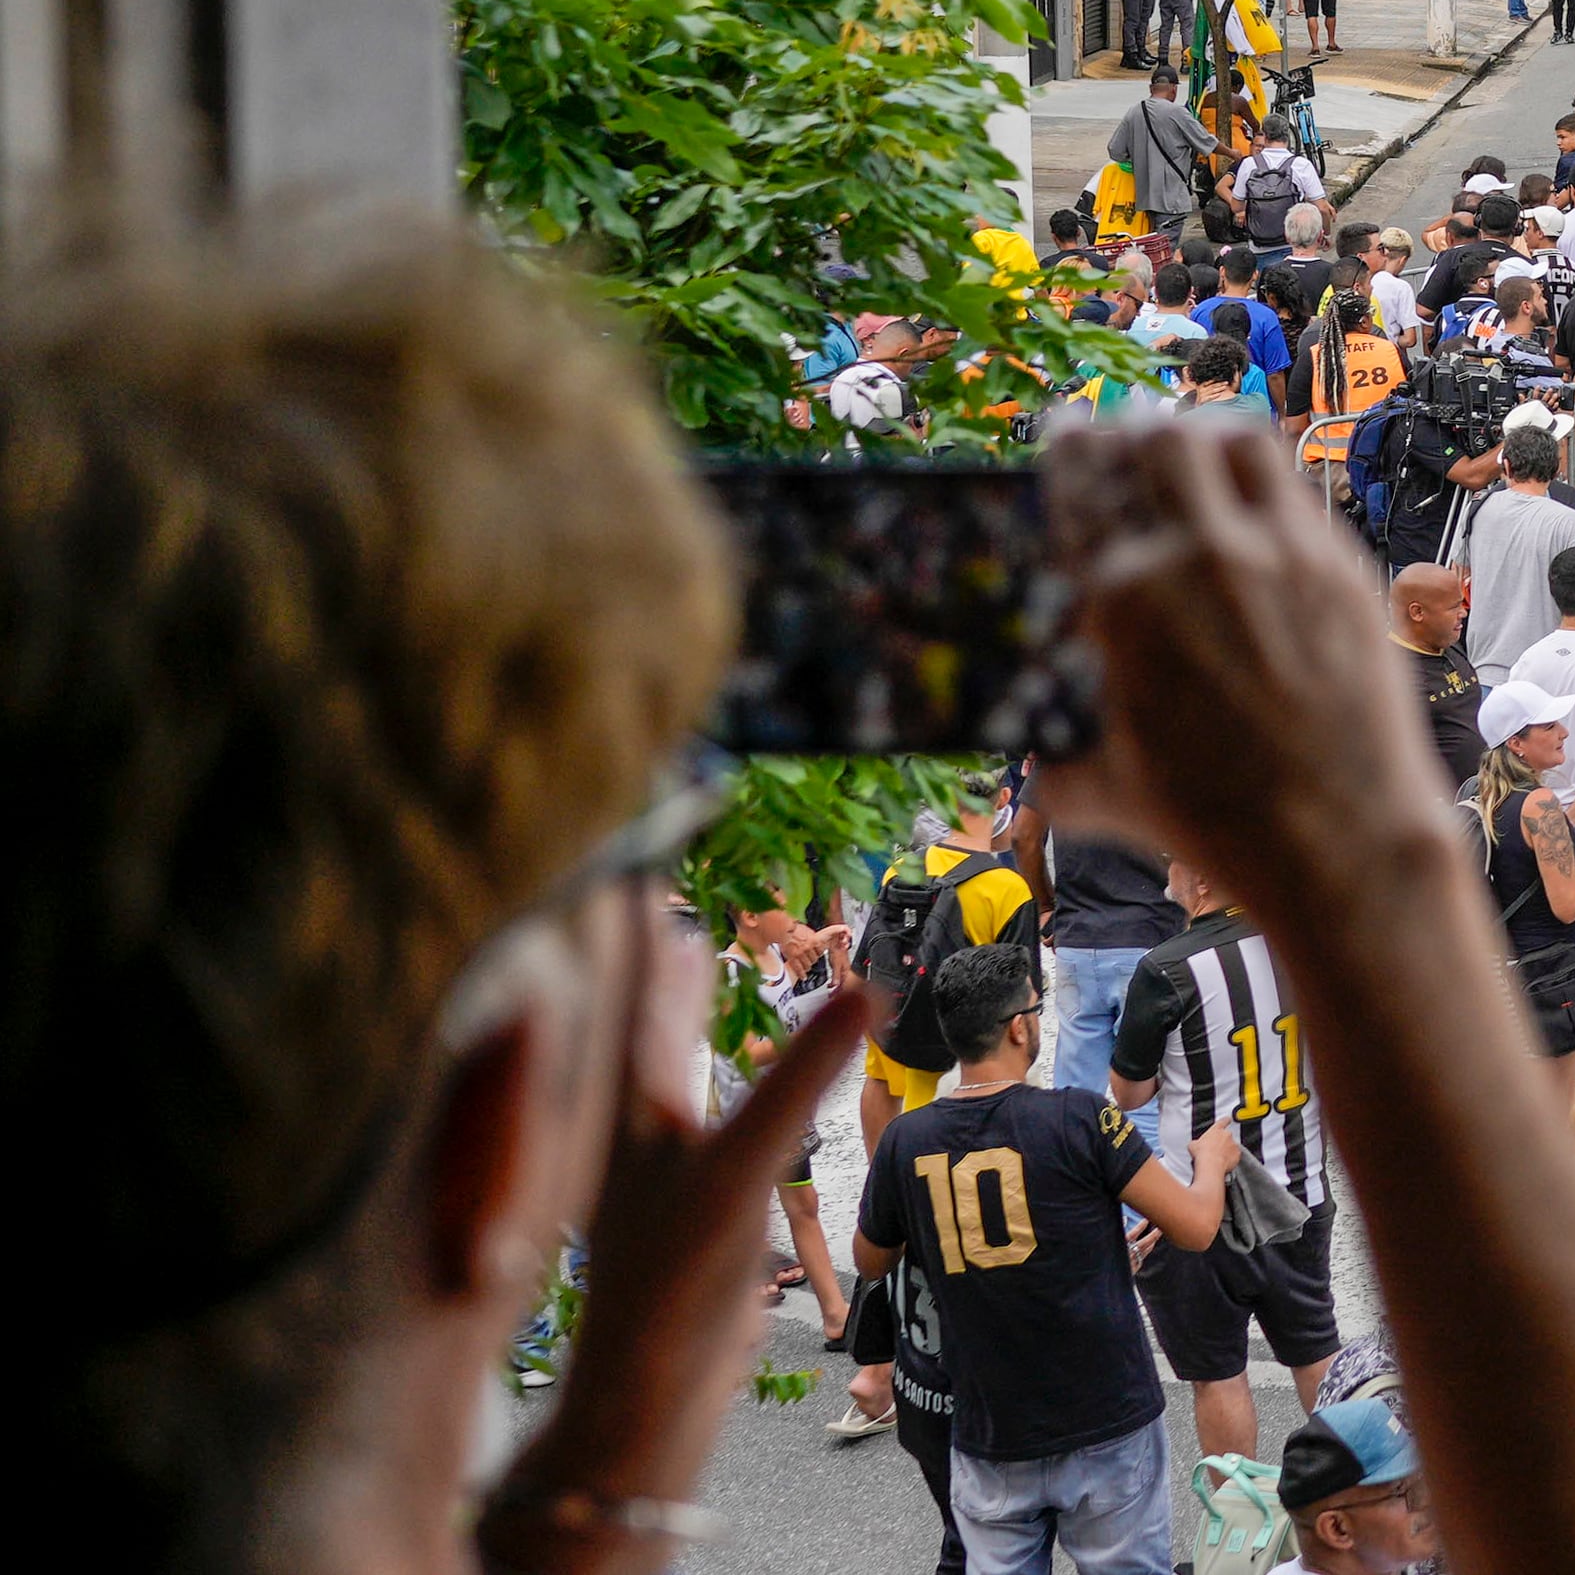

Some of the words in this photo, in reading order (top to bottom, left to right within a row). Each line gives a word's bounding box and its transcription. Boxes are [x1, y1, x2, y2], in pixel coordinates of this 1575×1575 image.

[1346, 342, 1376, 354] TAFF
[1350, 366, 1389, 389] 28
[1227, 1011, 1310, 1124] 11
[913, 1145, 1038, 1276] 10
[903, 1376, 955, 1416] SANTOS
